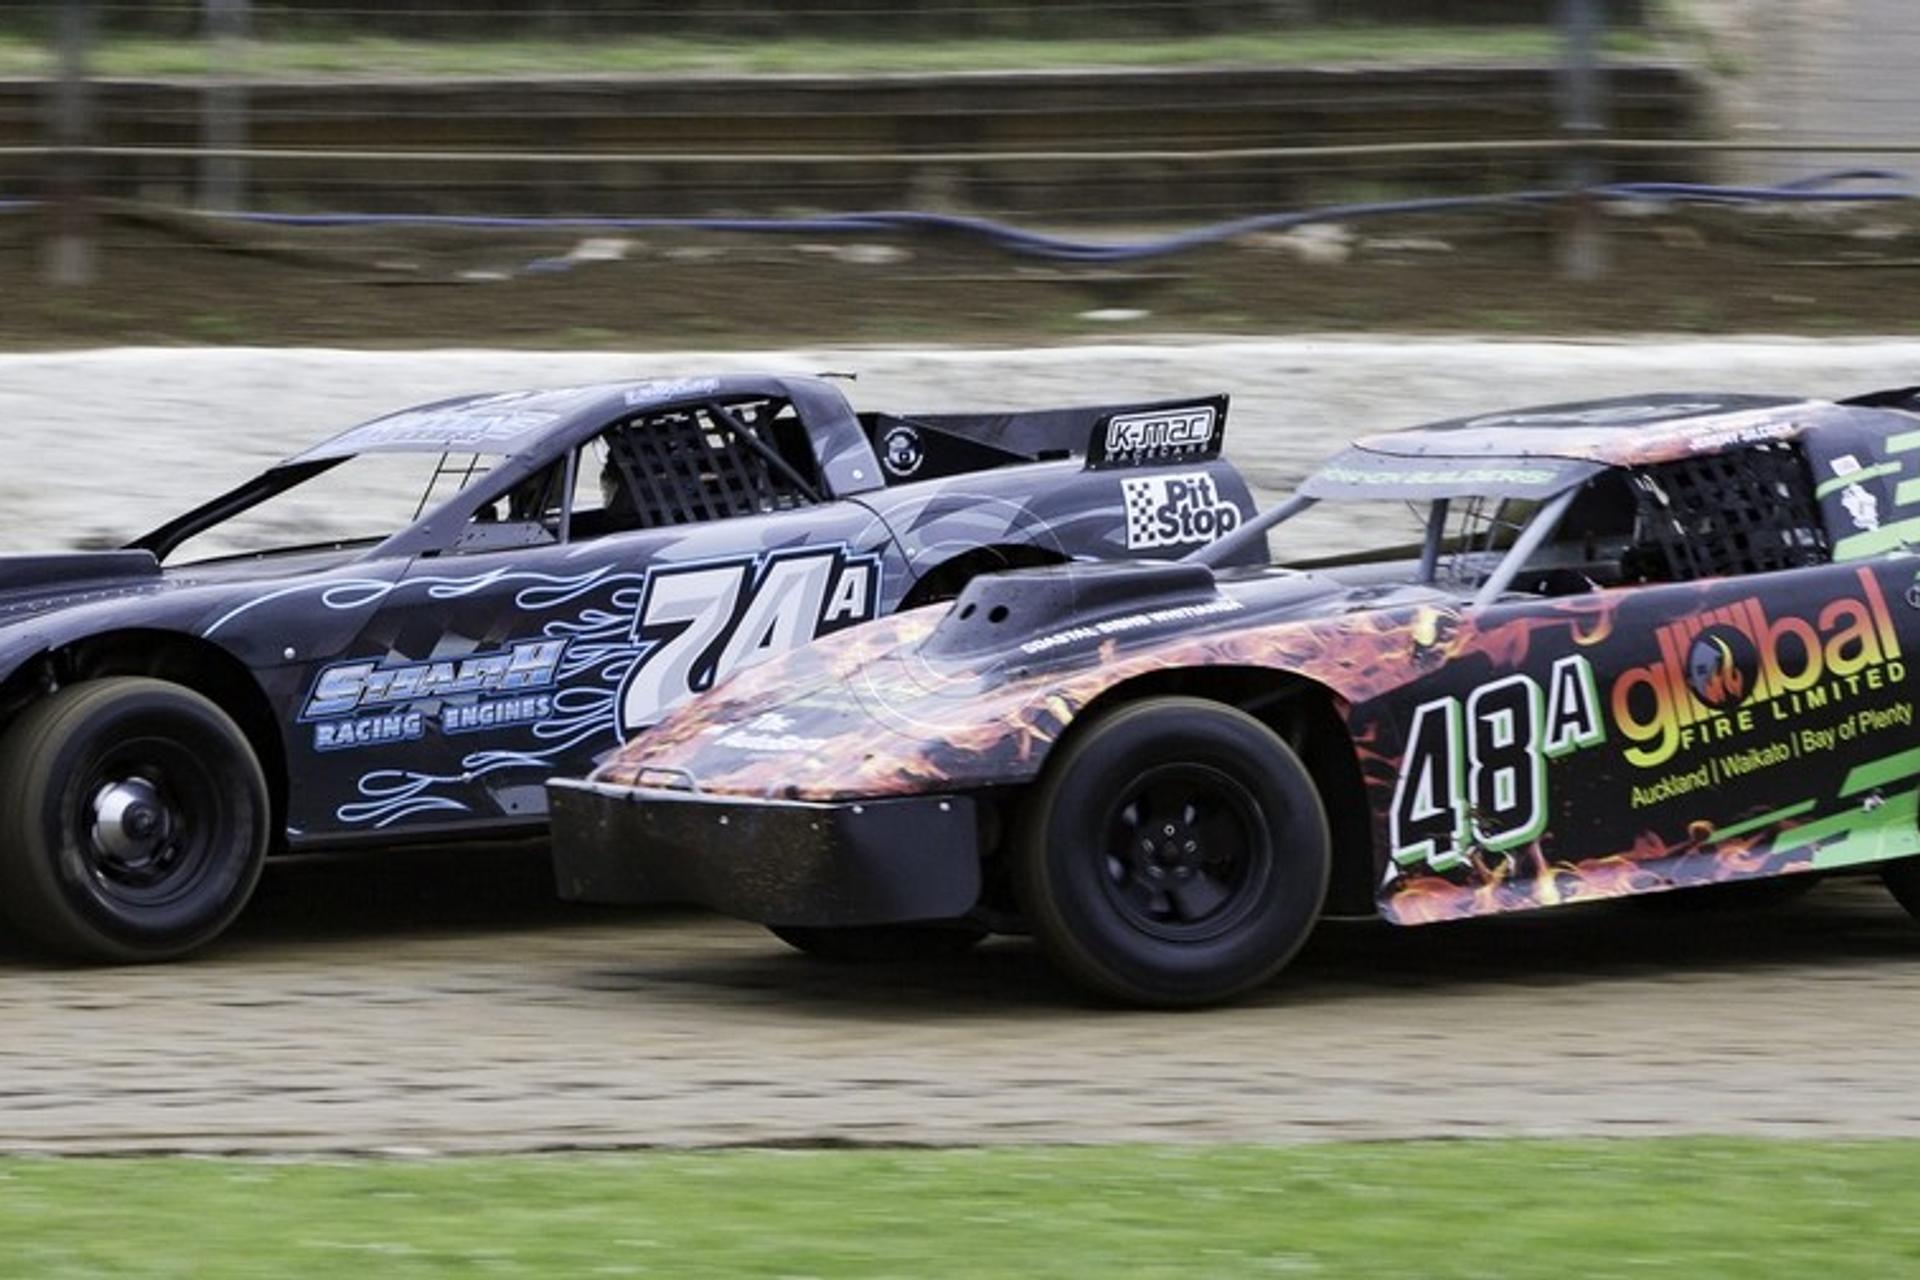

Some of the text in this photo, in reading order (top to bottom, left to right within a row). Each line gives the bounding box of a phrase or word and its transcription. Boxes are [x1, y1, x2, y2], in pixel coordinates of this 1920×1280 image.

[1156, 504, 1237, 541] Stop
[1164, 477, 1214, 514] Pit
[1612, 566, 1901, 768] global
[316, 697, 551, 751] RACING ENGINES
[1680, 662, 1906, 750] FIRE LIMITED
[1631, 701, 1914, 808] Auckland Waikato Bay of Plenty
